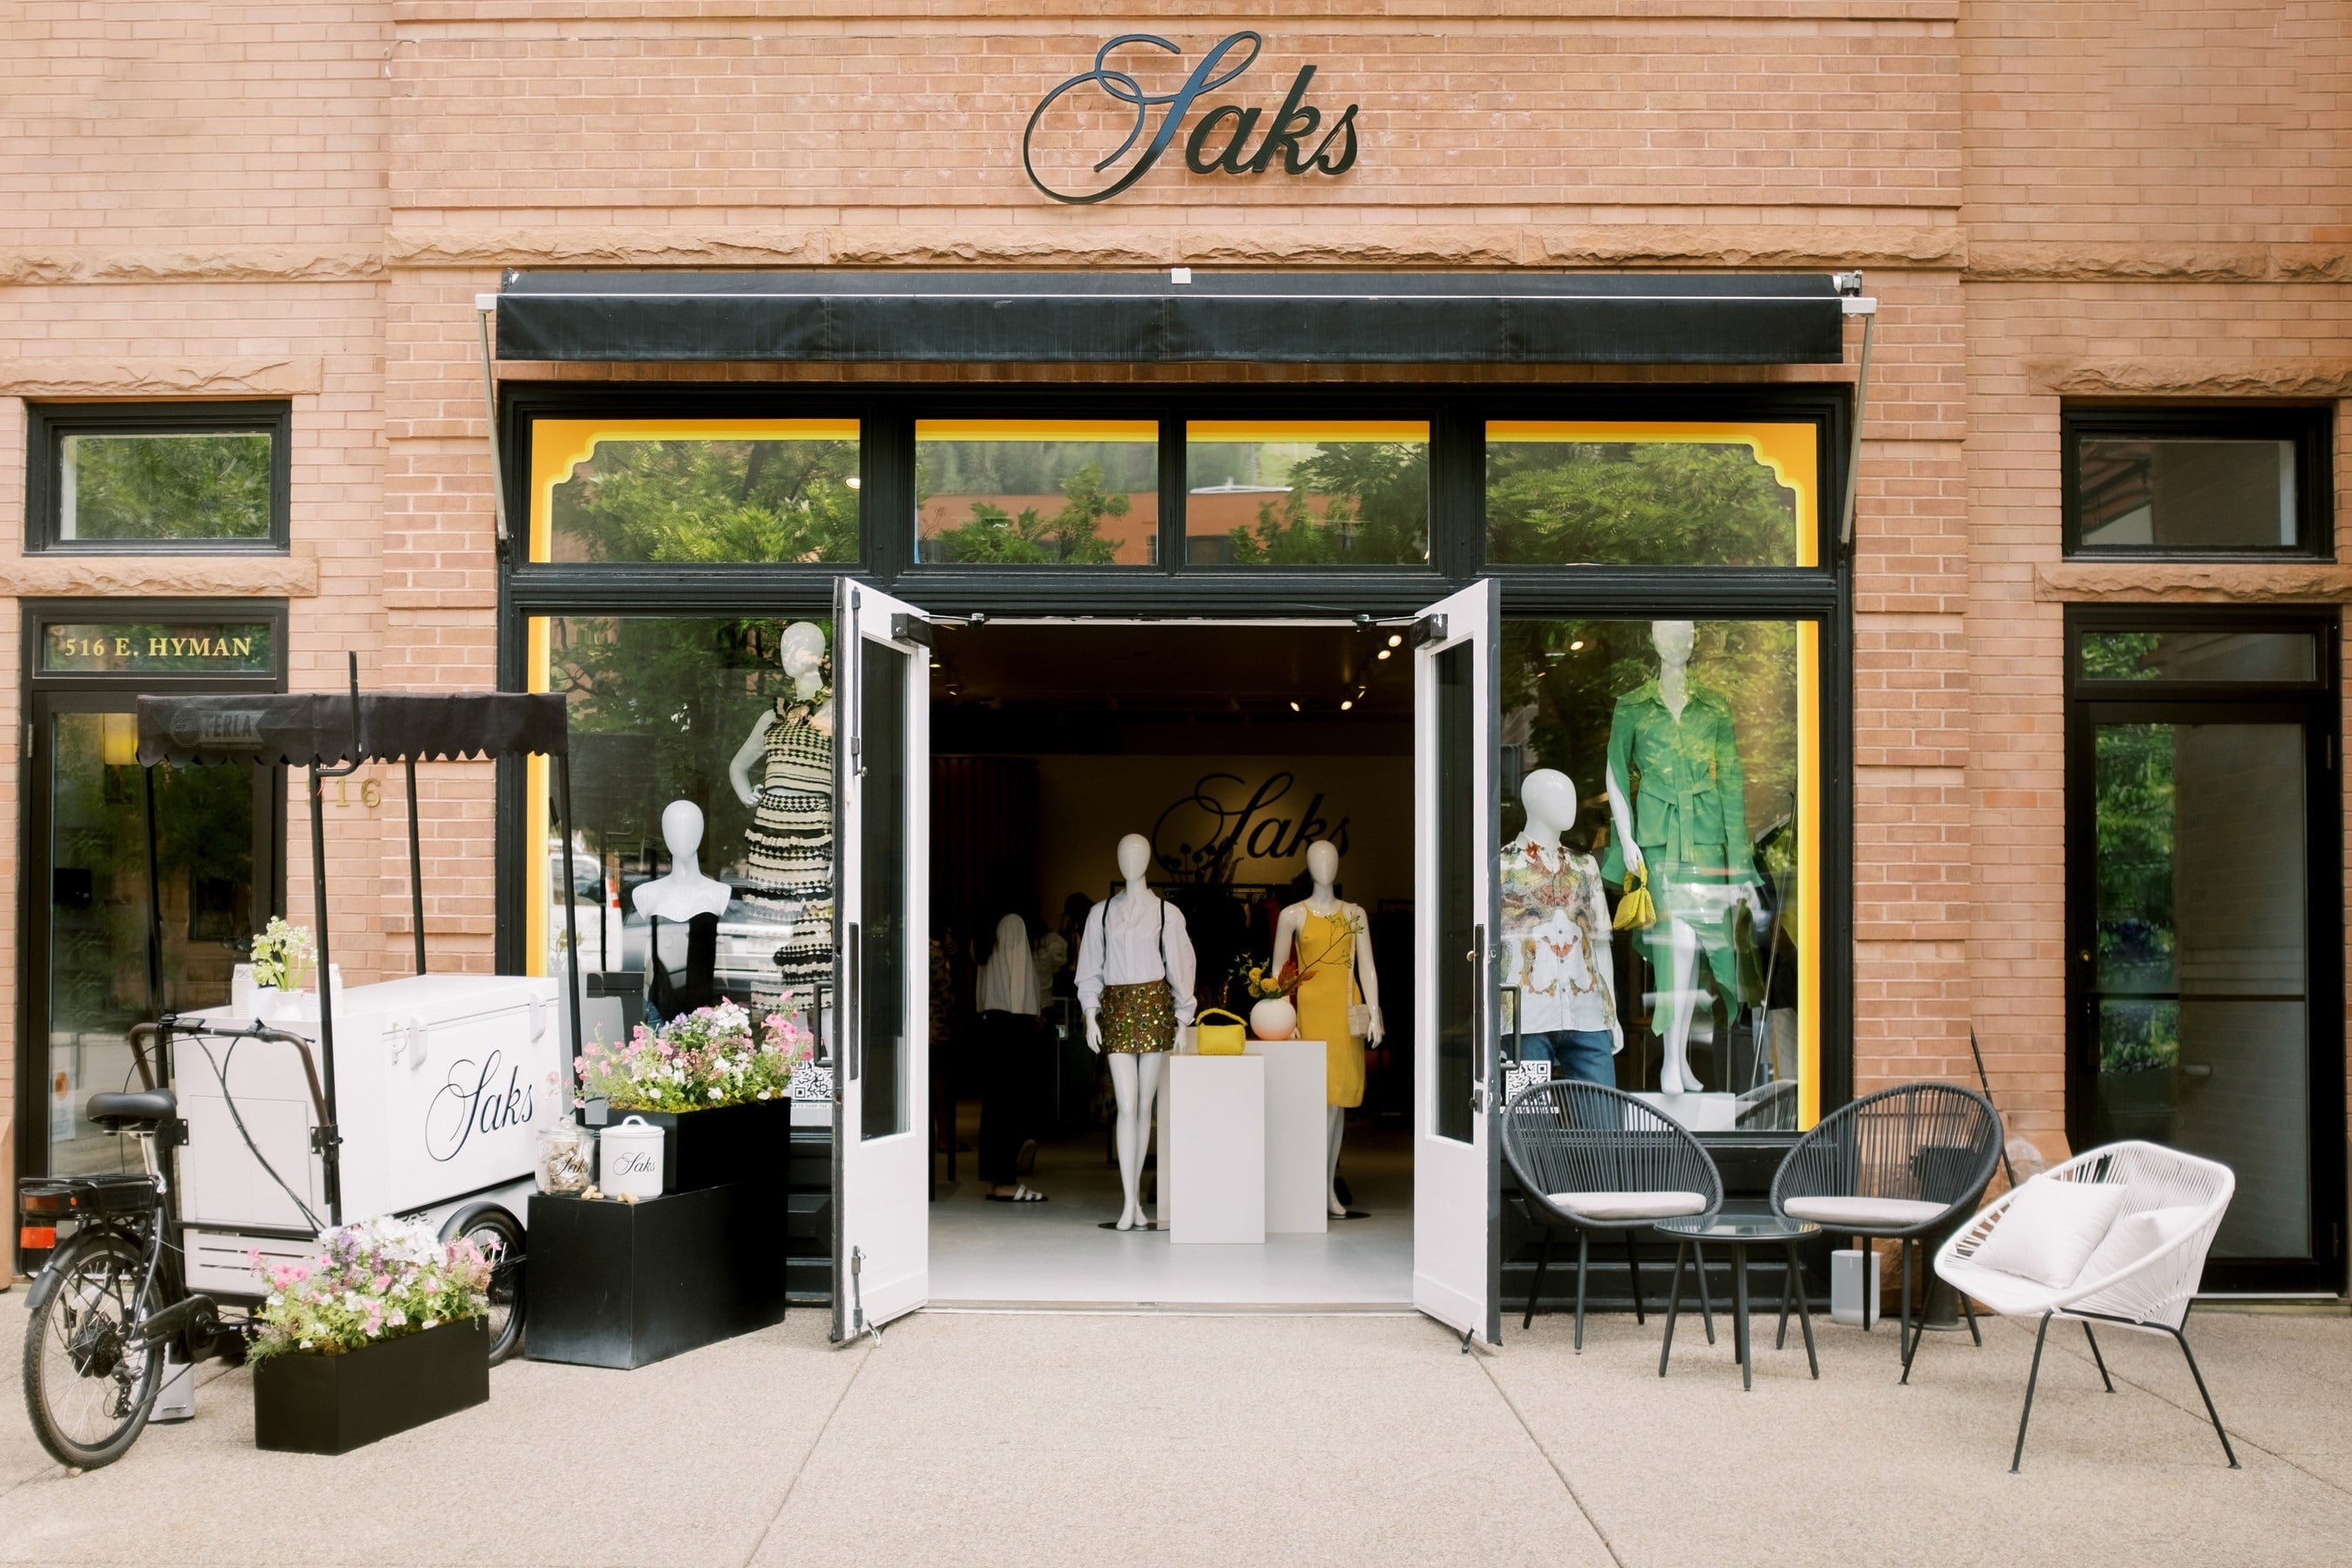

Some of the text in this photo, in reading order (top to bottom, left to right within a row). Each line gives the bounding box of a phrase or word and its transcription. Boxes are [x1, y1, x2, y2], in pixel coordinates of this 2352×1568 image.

[1023, 30, 1359, 204] Saks
[64, 638, 252, 657] 516 E. HYMAN
[201, 713, 252, 738] FERLA
[307, 778, 382, 808] 16
[1152, 772, 1350, 875] Saks
[425, 1050, 533, 1162] Saks
[547, 1153, 588, 1176] Saks
[612, 1152, 656, 1176] Saks
